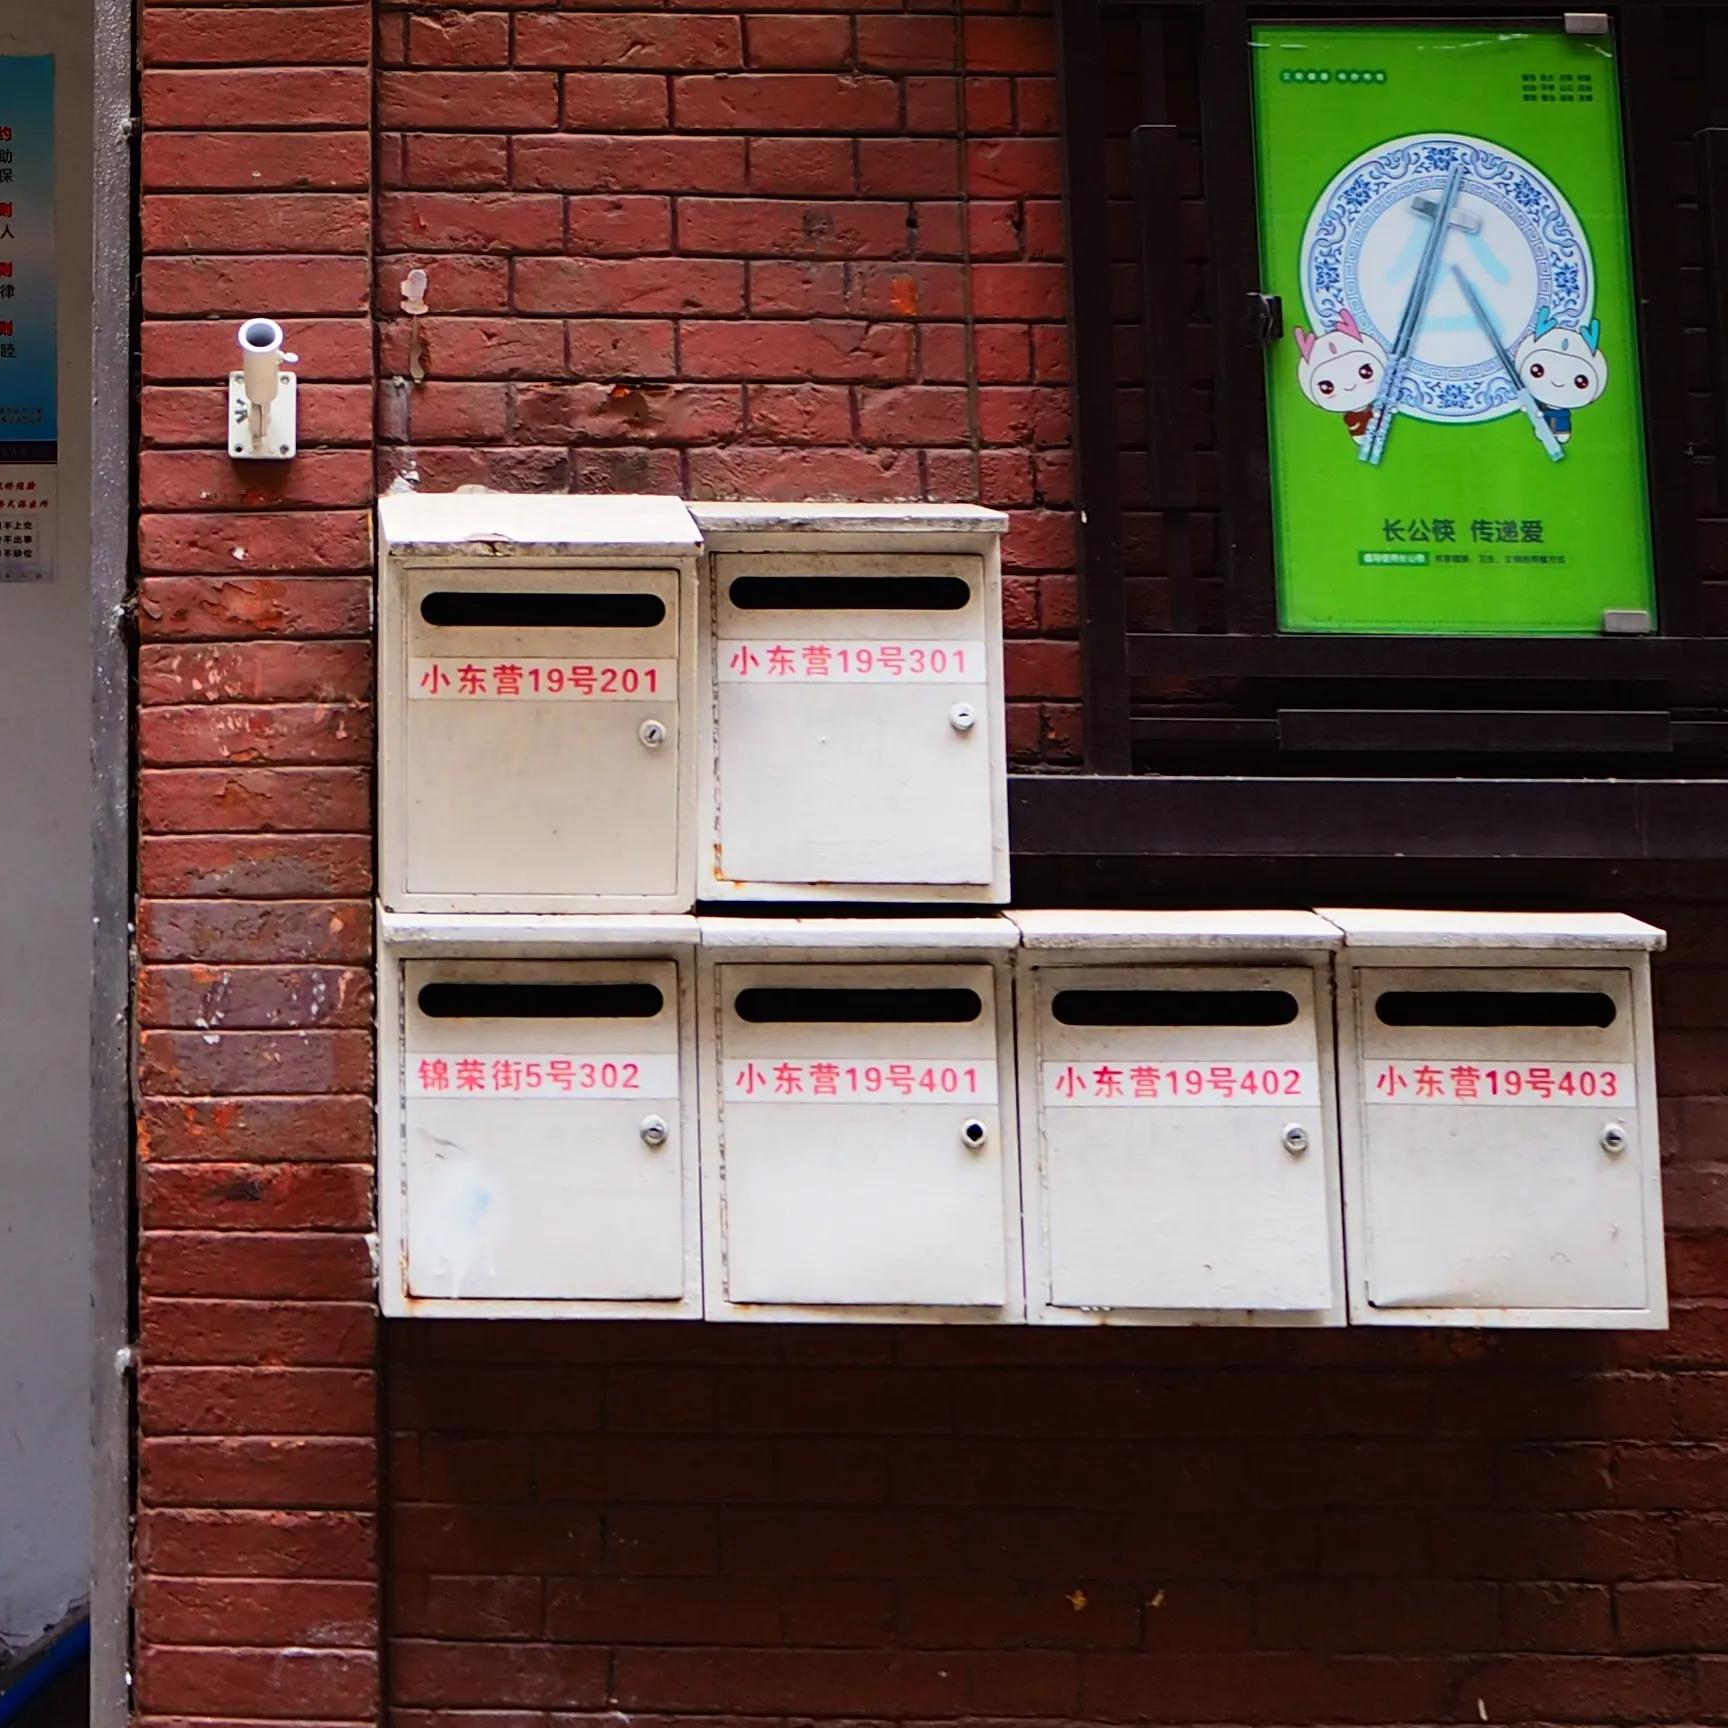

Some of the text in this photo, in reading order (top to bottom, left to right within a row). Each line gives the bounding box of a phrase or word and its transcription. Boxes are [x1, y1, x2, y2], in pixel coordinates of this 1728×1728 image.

[1383, 519, 1544, 543] 长公筷 传递爱
[419, 661, 661, 697] 小东营19号201
[729, 644, 966, 678] 小东营19号301
[417, 1057, 641, 1093] 锦荣街5号302
[735, 1061, 979, 1097] 小东营19号401
[1055, 1063, 1303, 1100] 小东营19号402
[1375, 1064, 1620, 1101] 小东营19号403
